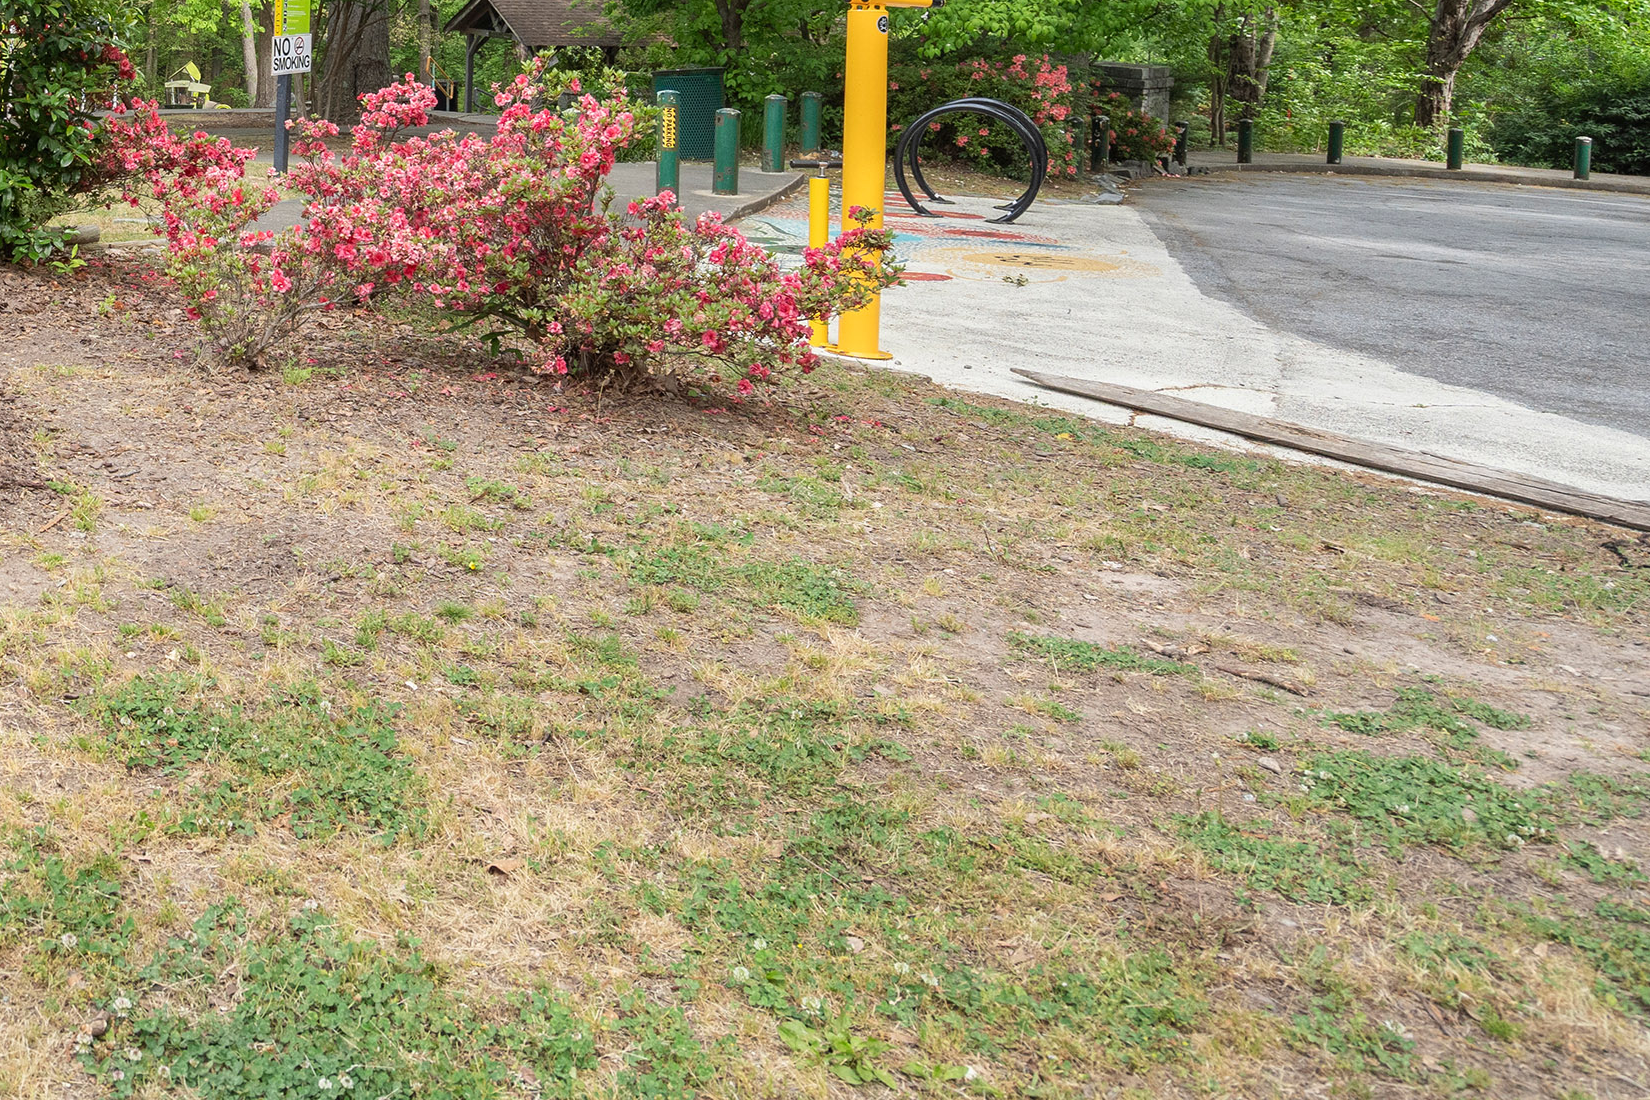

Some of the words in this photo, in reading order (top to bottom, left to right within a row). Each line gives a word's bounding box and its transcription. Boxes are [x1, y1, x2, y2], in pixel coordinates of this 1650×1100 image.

[274, 38, 290, 56] NO
[273, 55, 310, 71] SMOKING
[666, 108, 672, 117] NO
